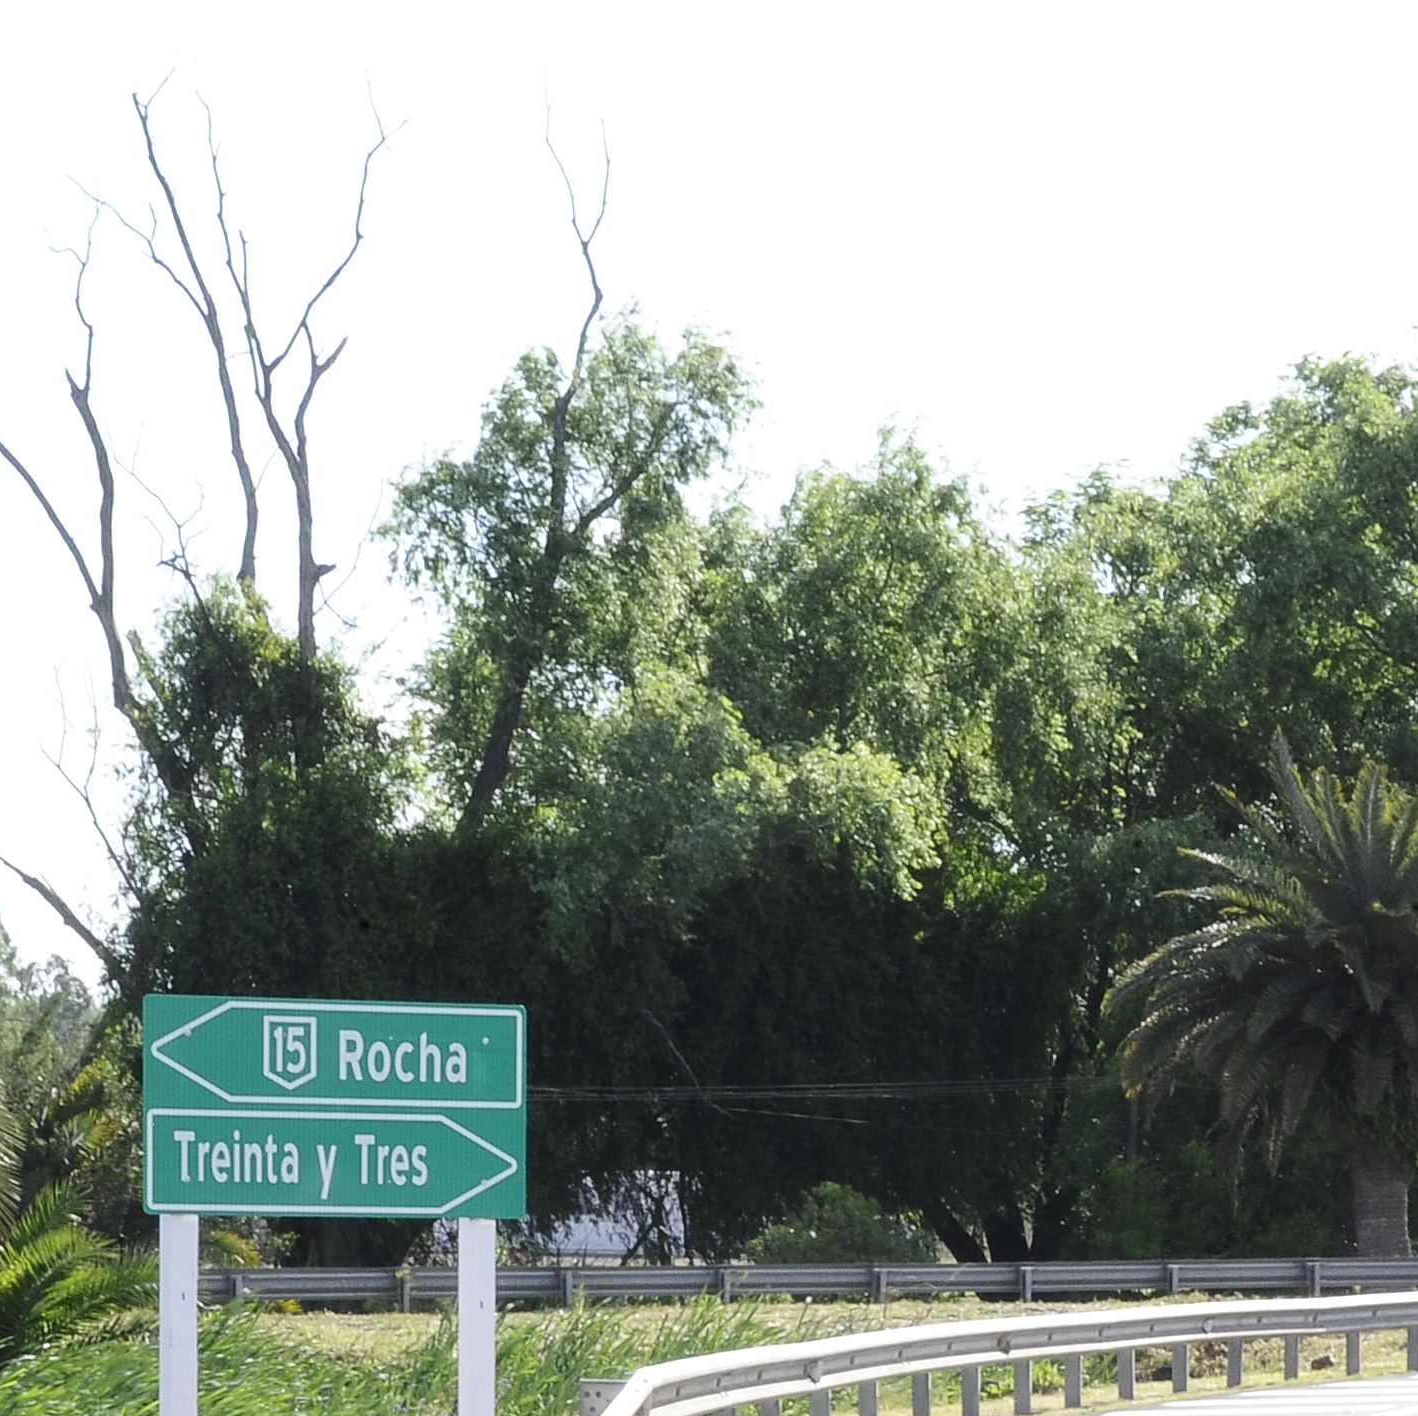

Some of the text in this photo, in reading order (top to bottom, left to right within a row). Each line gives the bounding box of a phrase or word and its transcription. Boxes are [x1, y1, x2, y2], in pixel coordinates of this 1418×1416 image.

[274, 1026, 467, 1083] 15 Rocha
[173, 1130, 428, 1200] Treinta y Tres
